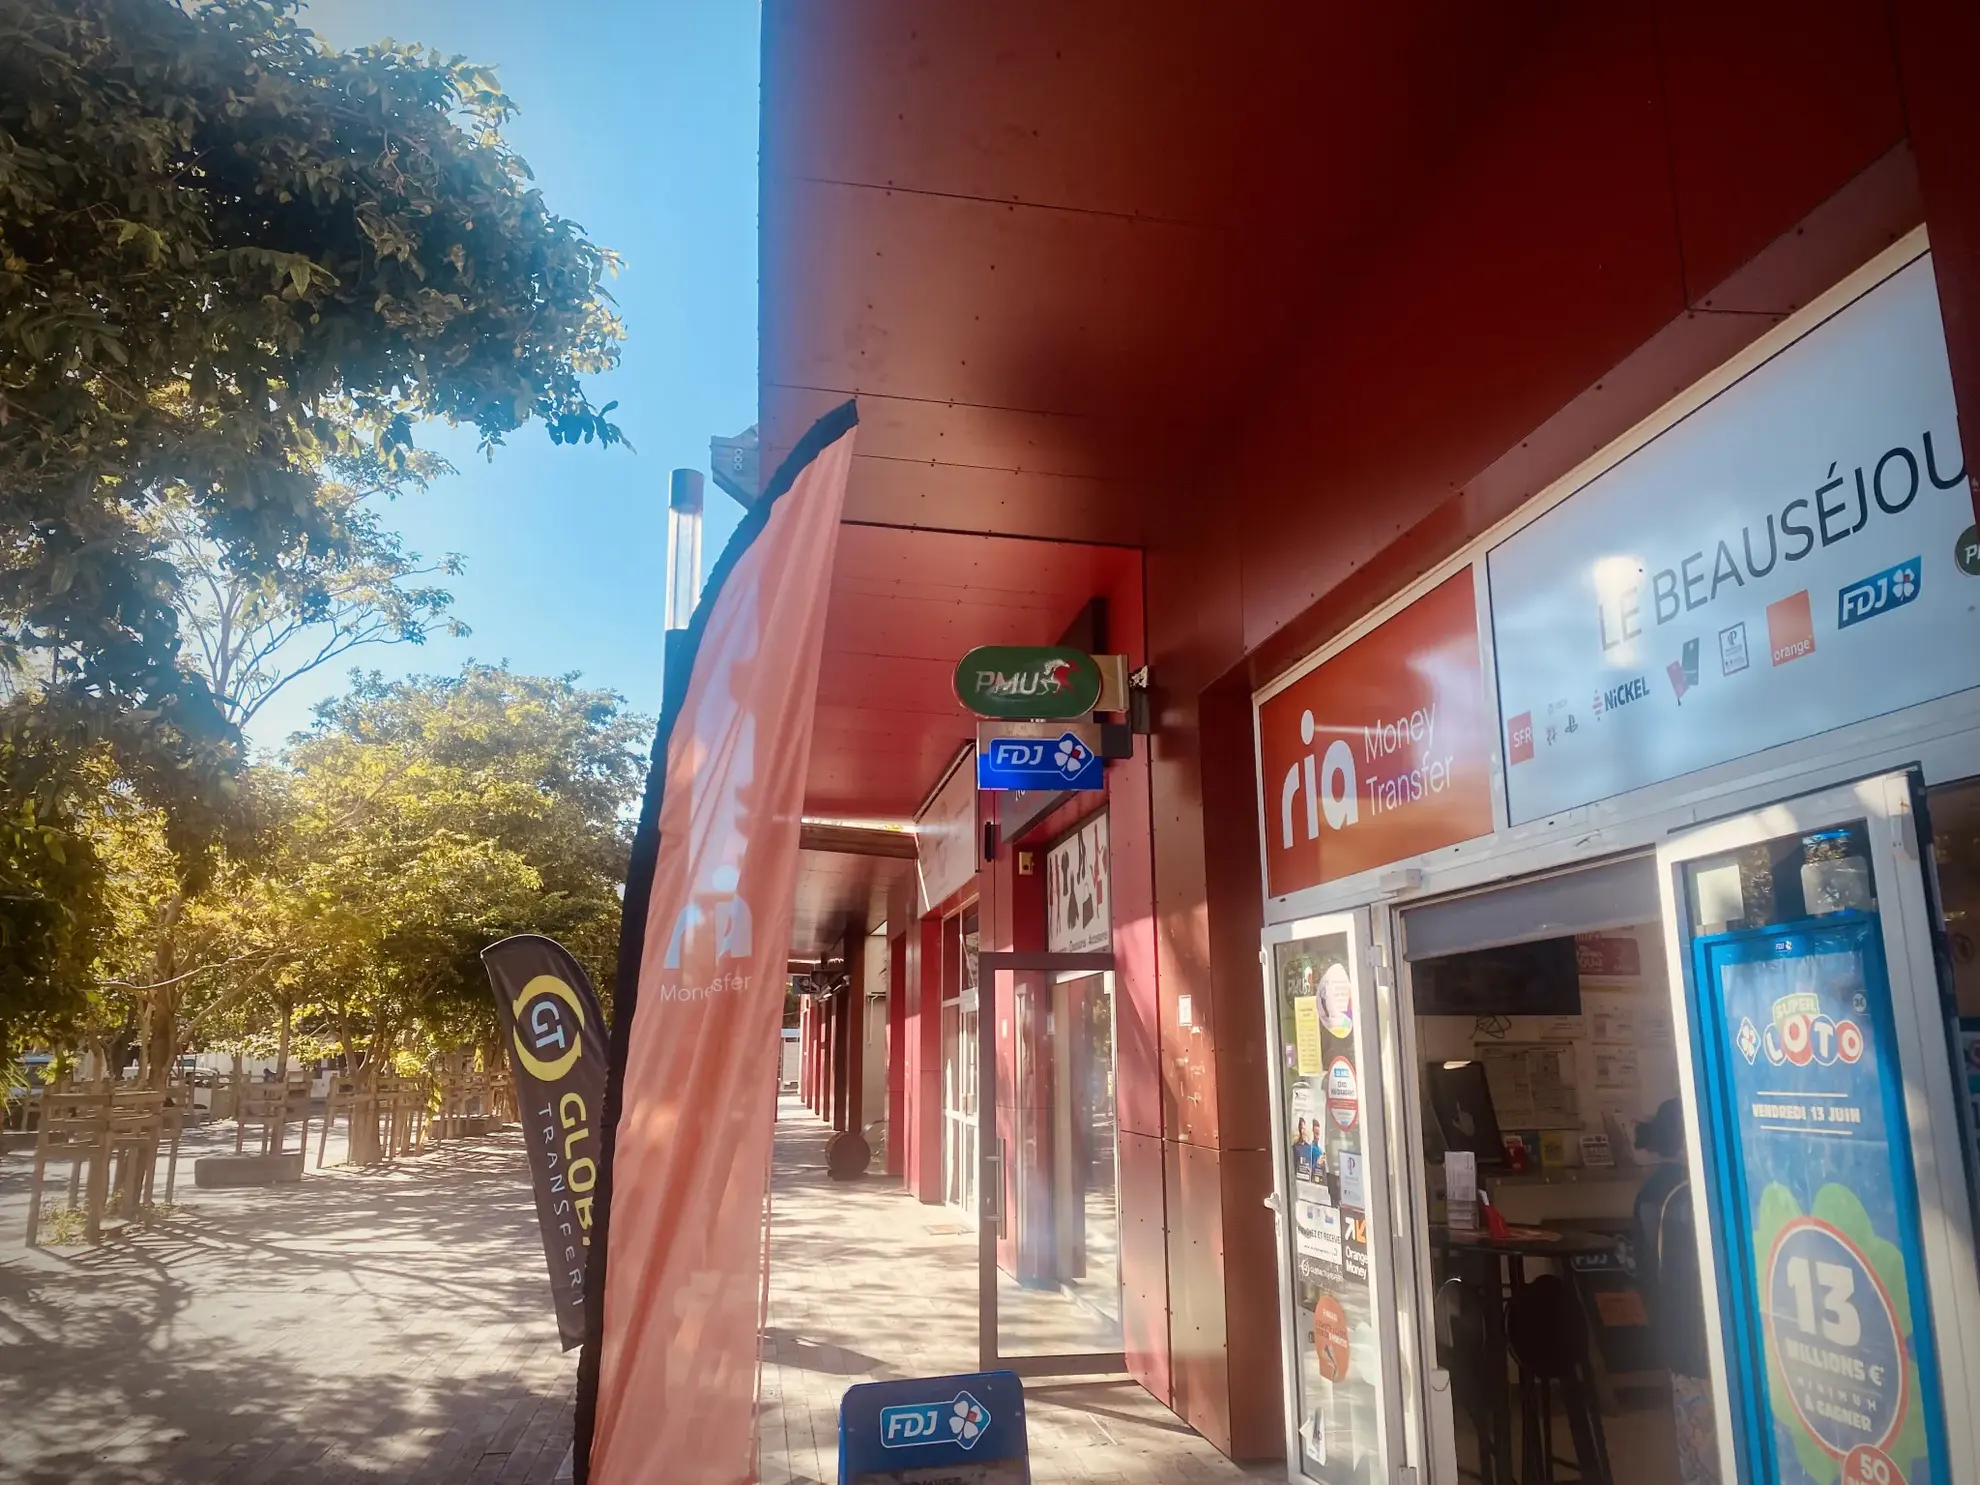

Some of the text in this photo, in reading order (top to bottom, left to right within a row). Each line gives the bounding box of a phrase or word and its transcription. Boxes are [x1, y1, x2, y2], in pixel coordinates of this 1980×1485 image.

[1599, 430, 1966, 651] LE BEAUSÉJOU
[1965, 544, 1980, 564] P
[1842, 577, 1888, 621] FDJ
[1773, 639, 1810, 661] orange
[975, 671, 1039, 694] PMU
[1364, 702, 1437, 763] Money
[1513, 726, 1532, 748] SFR
[996, 745, 1043, 765] FDJ
[1282, 709, 1359, 850] ria
[1366, 751, 1454, 816] Transfer
[532, 1001, 565, 1049] GT
[1765, 1015, 1861, 1061] LOTO
[1752, 1104, 1861, 1123] VENDREDI 13 JUIN
[1346, 1260, 1367, 1280] Money
[1787, 1256, 1861, 1347] 13
[1785, 1338, 1865, 1380] MILLIONS
[888, 1411, 938, 1439] FDJ
[1860, 1452, 1890, 1485] 50
